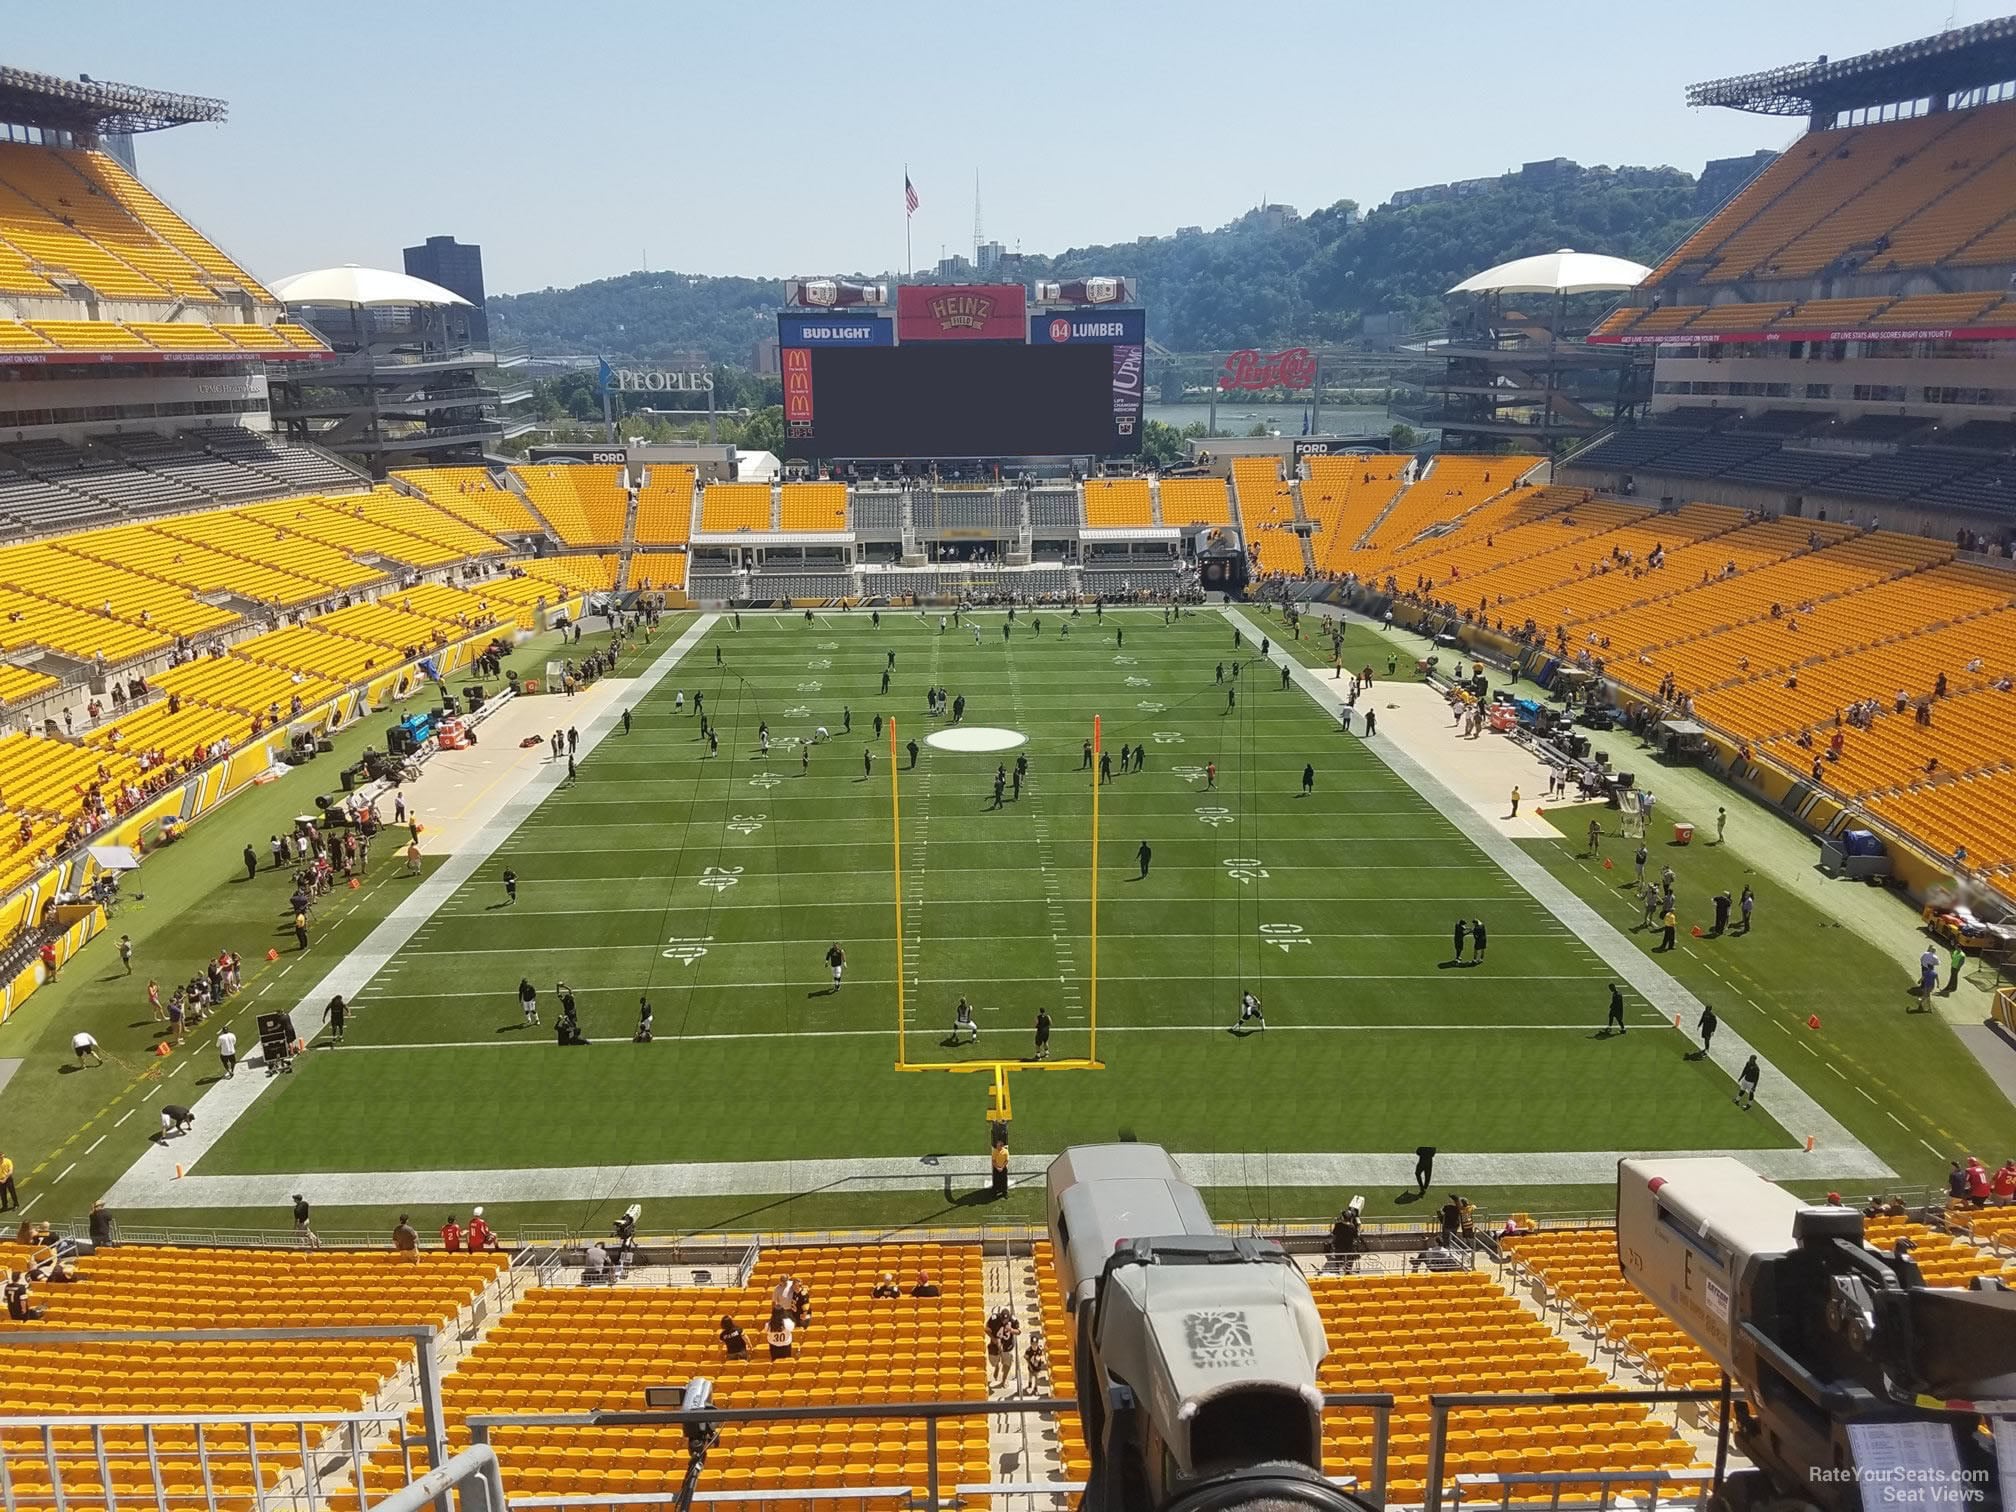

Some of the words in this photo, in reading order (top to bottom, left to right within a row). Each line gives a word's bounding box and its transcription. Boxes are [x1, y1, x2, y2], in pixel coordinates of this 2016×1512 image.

[932, 296, 990, 318] HEINZ
[952, 316, 972, 325] FIELD
[802, 328, 831, 339] BUD
[832, 328, 871, 339] LIGHT
[1052, 324, 1068, 337] 84
[1072, 323, 1124, 337] LUMBER
[618, 369, 714, 391] PEOPLES
[1296, 444, 1328, 454] FORD
[592, 454, 625, 462] FORD
[1152, 732, 1186, 743] 50
[750, 772, 784, 786] 40
[1172, 766, 1207, 780] 40
[727, 814, 767, 830] 30
[1194, 807, 1235, 823] 30
[1222, 858, 1270, 878] 20
[698, 866, 744, 886] 20
[1258, 924, 1312, 945] 10
[662, 936, 714, 958] 10
[448, 1232, 453, 1240] 2
[1685, 1248, 1693, 1290] E
[773, 1332, 786, 1342] 30
[996, 1326, 1010, 1340] 43
[1191, 1348, 1254, 1360] LYON
